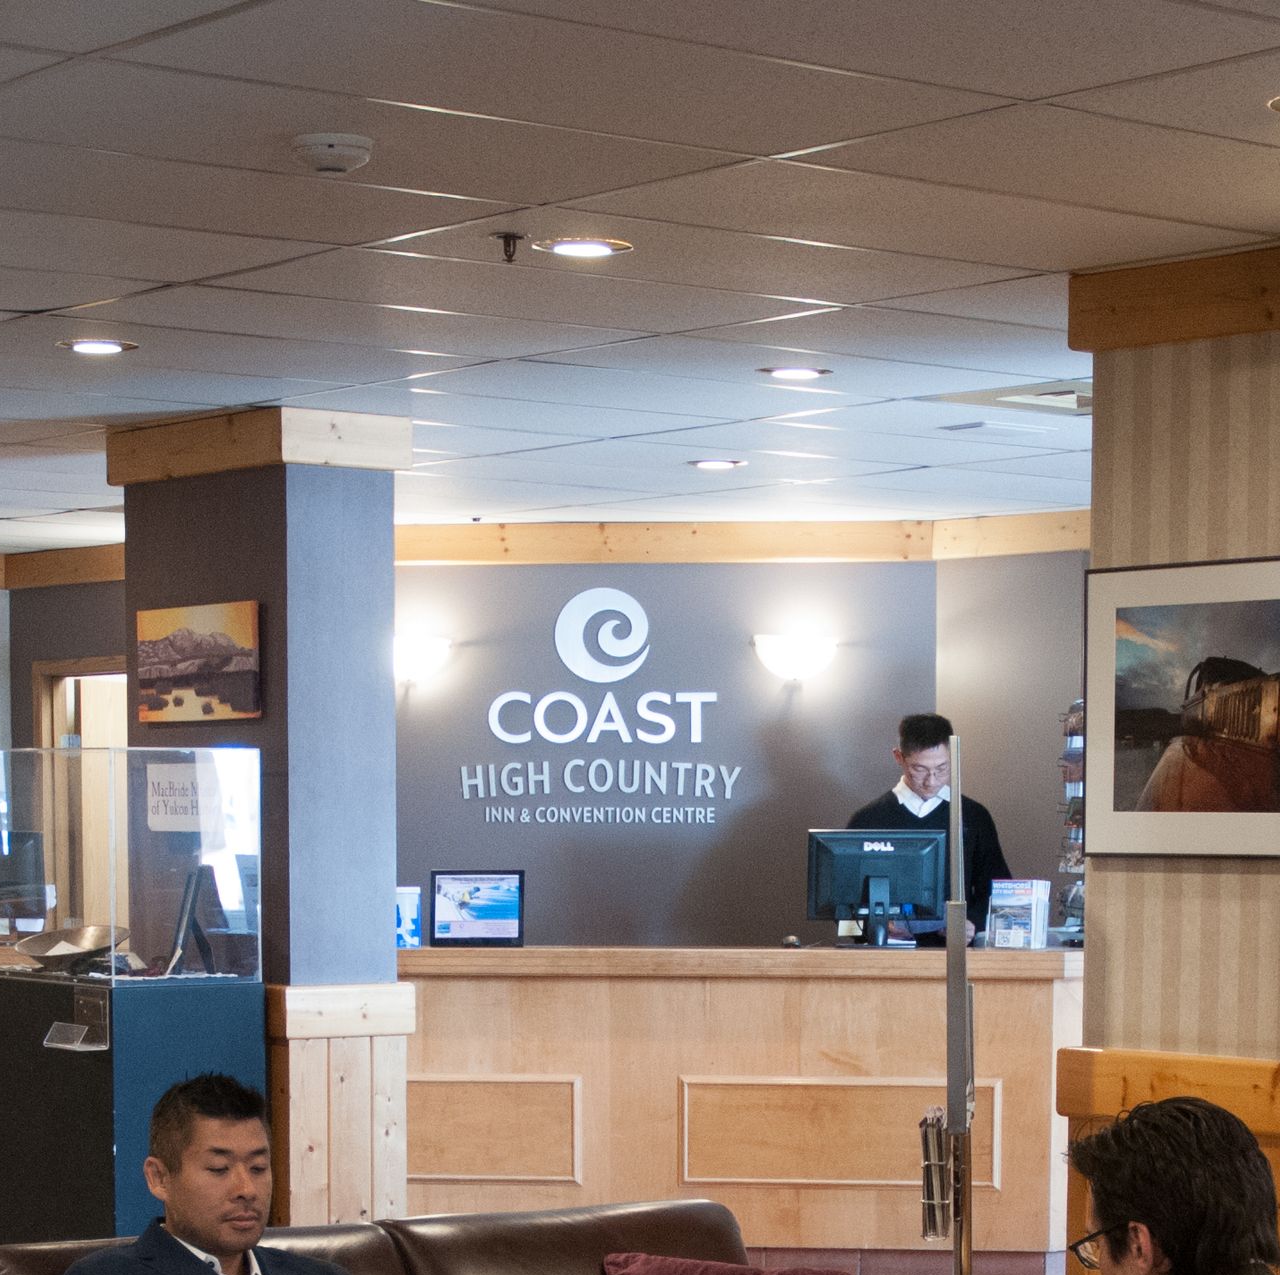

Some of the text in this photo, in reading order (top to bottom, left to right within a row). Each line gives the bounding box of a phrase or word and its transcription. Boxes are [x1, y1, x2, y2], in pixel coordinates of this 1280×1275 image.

[487, 690, 718, 744] COAST
[460, 758, 742, 800] HIGH COUNTRY
[151, 781, 190, 797] MacBride
[151, 800, 161, 815] of
[162, 800, 190, 815] Yukon
[485, 806, 716, 824] INN & CONVENTION CENTRE
[863, 842, 895, 852] DELL
